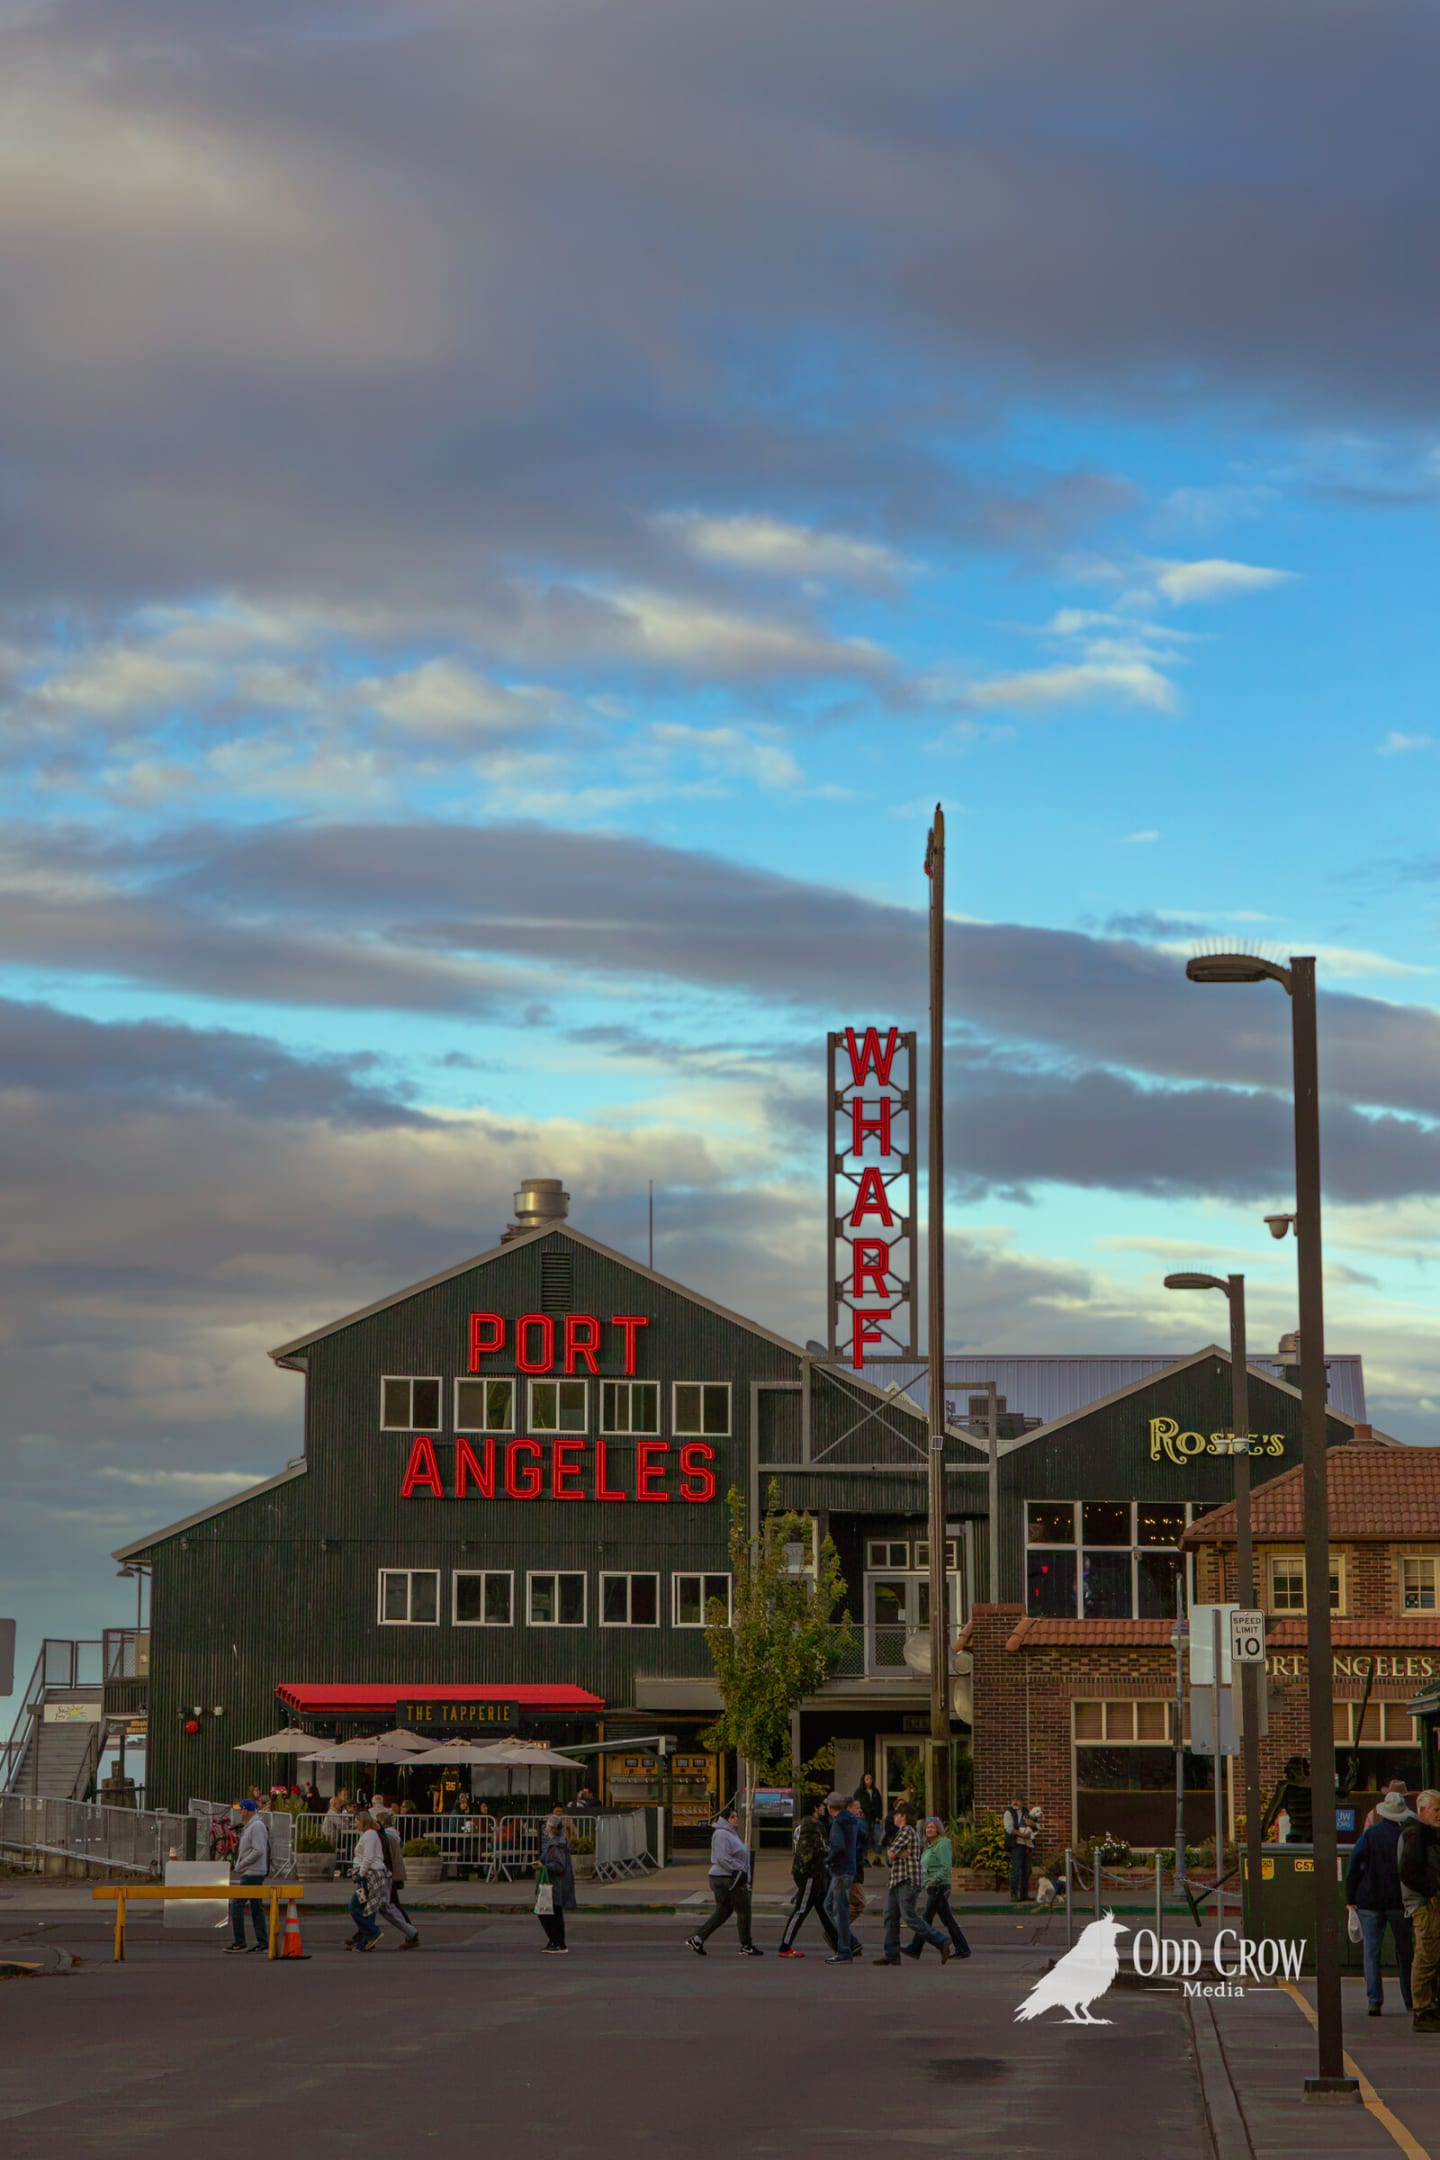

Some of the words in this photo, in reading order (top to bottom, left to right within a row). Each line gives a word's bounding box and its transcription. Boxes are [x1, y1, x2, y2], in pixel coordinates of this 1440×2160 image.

[844, 1027, 899, 1369] WHARF
[468, 1311, 649, 1376] PORT
[400, 1436, 717, 1503] ANGELES
[1233, 1617, 1261, 1625] SPEED
[1236, 1626, 1258, 1634] LIMIT
[1235, 1637, 1260, 1656] 10
[1332, 1656, 1434, 1678] NGELES
[406, 1705, 433, 1721] THE
[441, 1705, 511, 1721] TAPPERIE
[1337, 1811, 1351, 1821] JW
